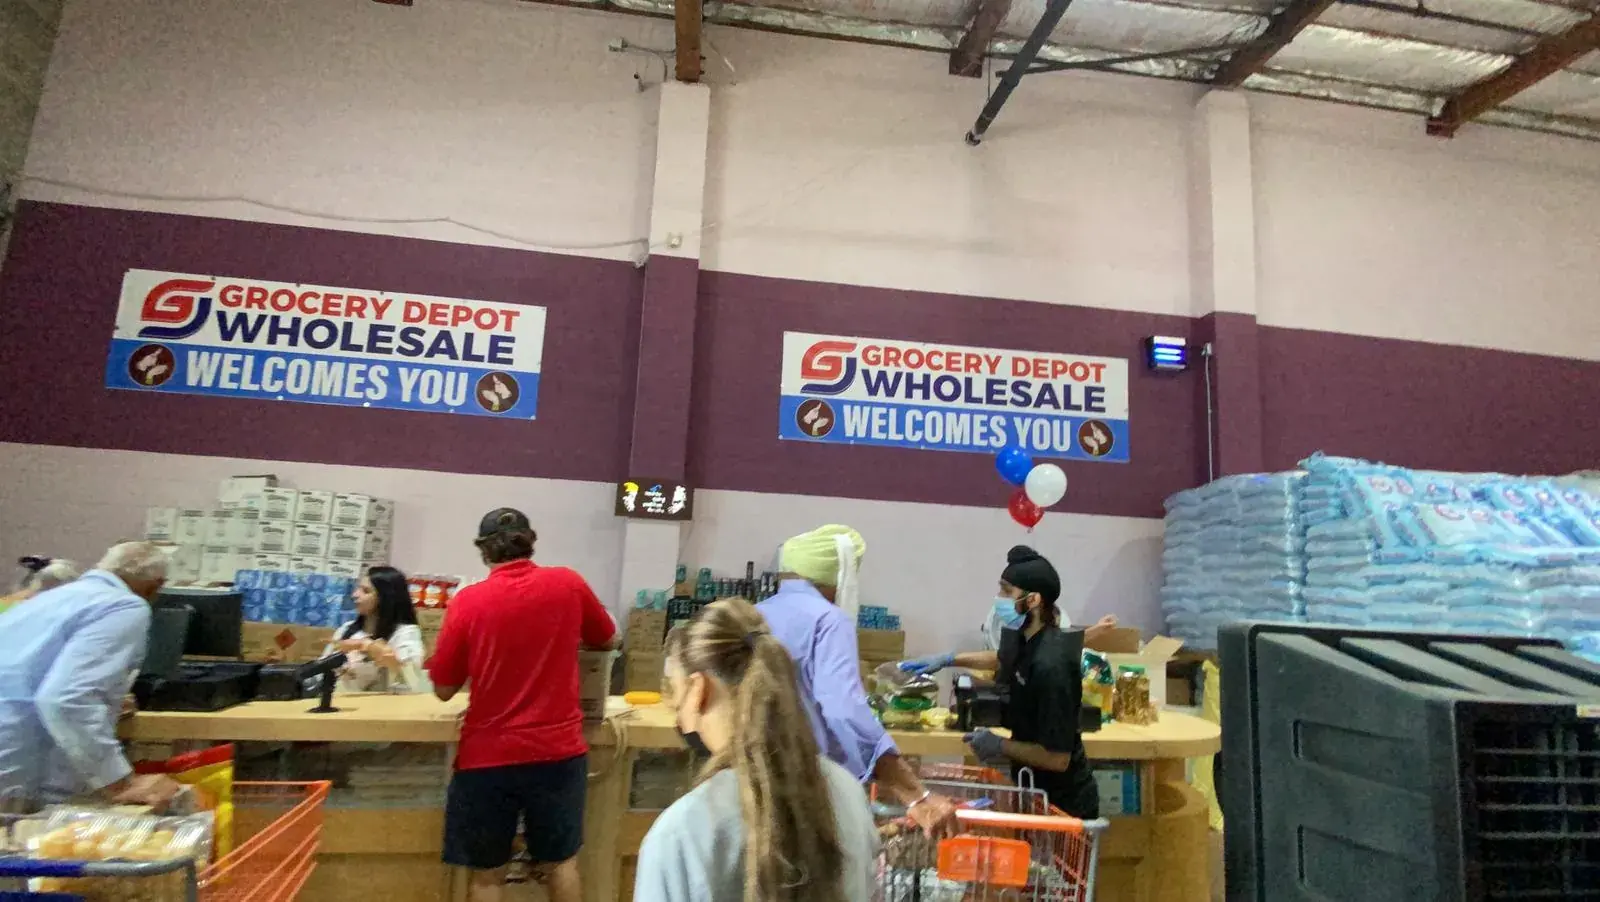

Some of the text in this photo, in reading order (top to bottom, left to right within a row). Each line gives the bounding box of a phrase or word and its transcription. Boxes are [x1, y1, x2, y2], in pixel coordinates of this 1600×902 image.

[219, 285, 520, 332] GROCERY DEPOT
[217, 310, 514, 365] WHOLESALE
[186, 351, 468, 406] WELCOMES YOU
[861, 345, 1107, 383] GROCERY DEPOT
[861, 369, 1106, 413] WHOLESALE
[843, 404, 1071, 452] WELCOMES YOU
